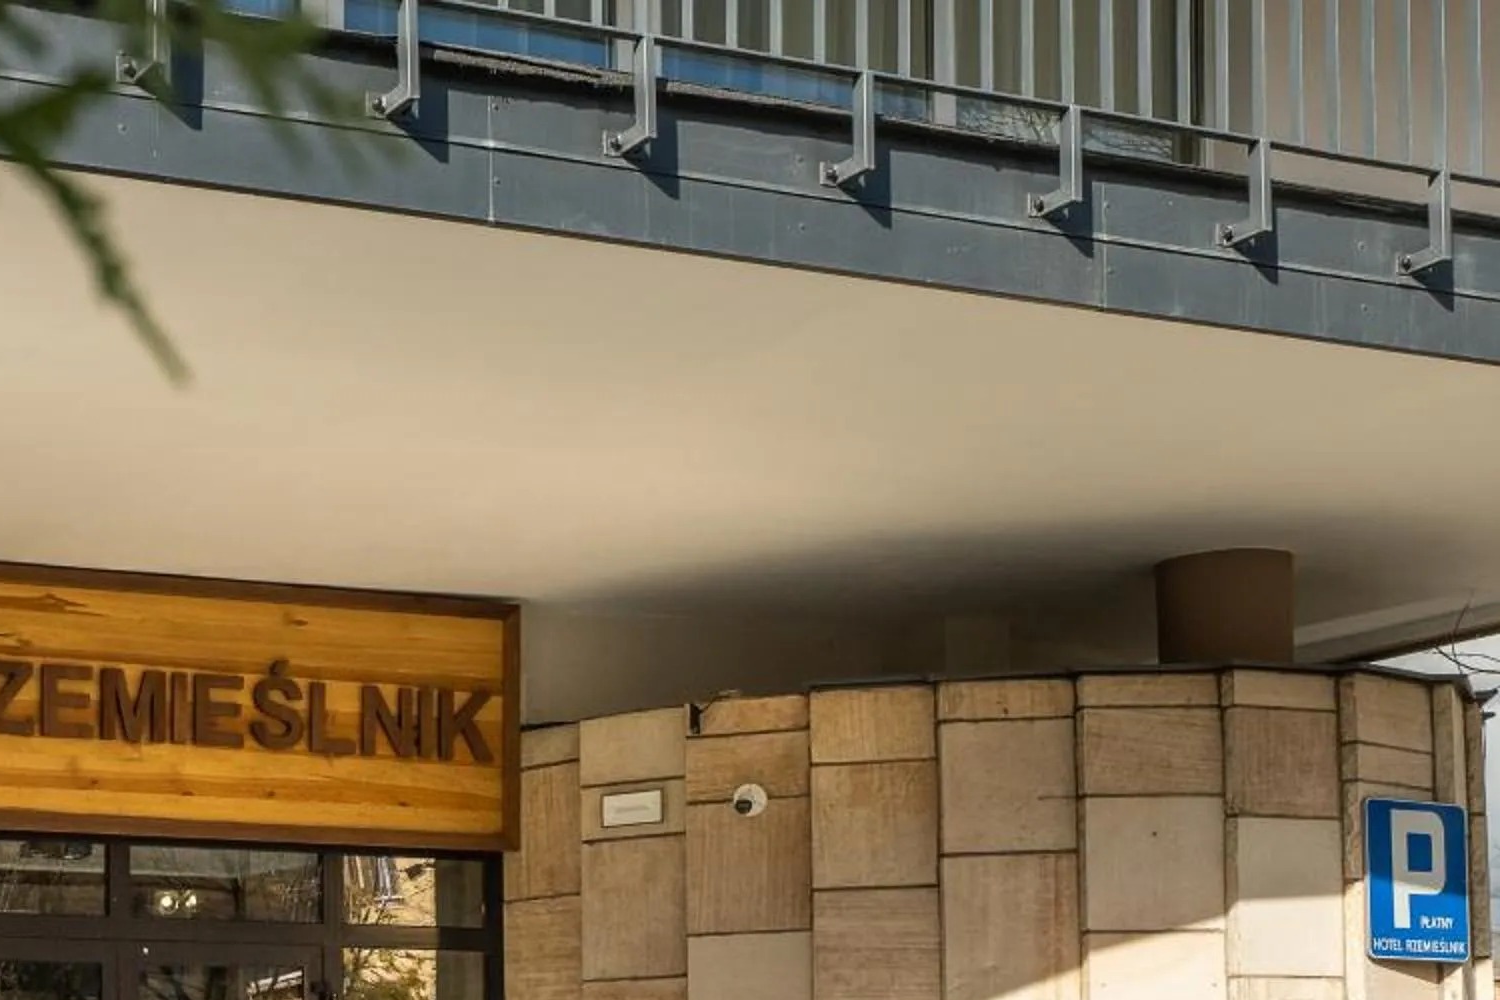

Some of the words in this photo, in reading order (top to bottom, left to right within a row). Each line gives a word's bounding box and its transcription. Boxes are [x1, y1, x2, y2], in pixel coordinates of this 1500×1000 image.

[1390, 808, 1446, 928] P
[1373, 937, 1403, 951] HOTEL
[1405, 937, 1467, 954] RZEMIEŚLNIK
